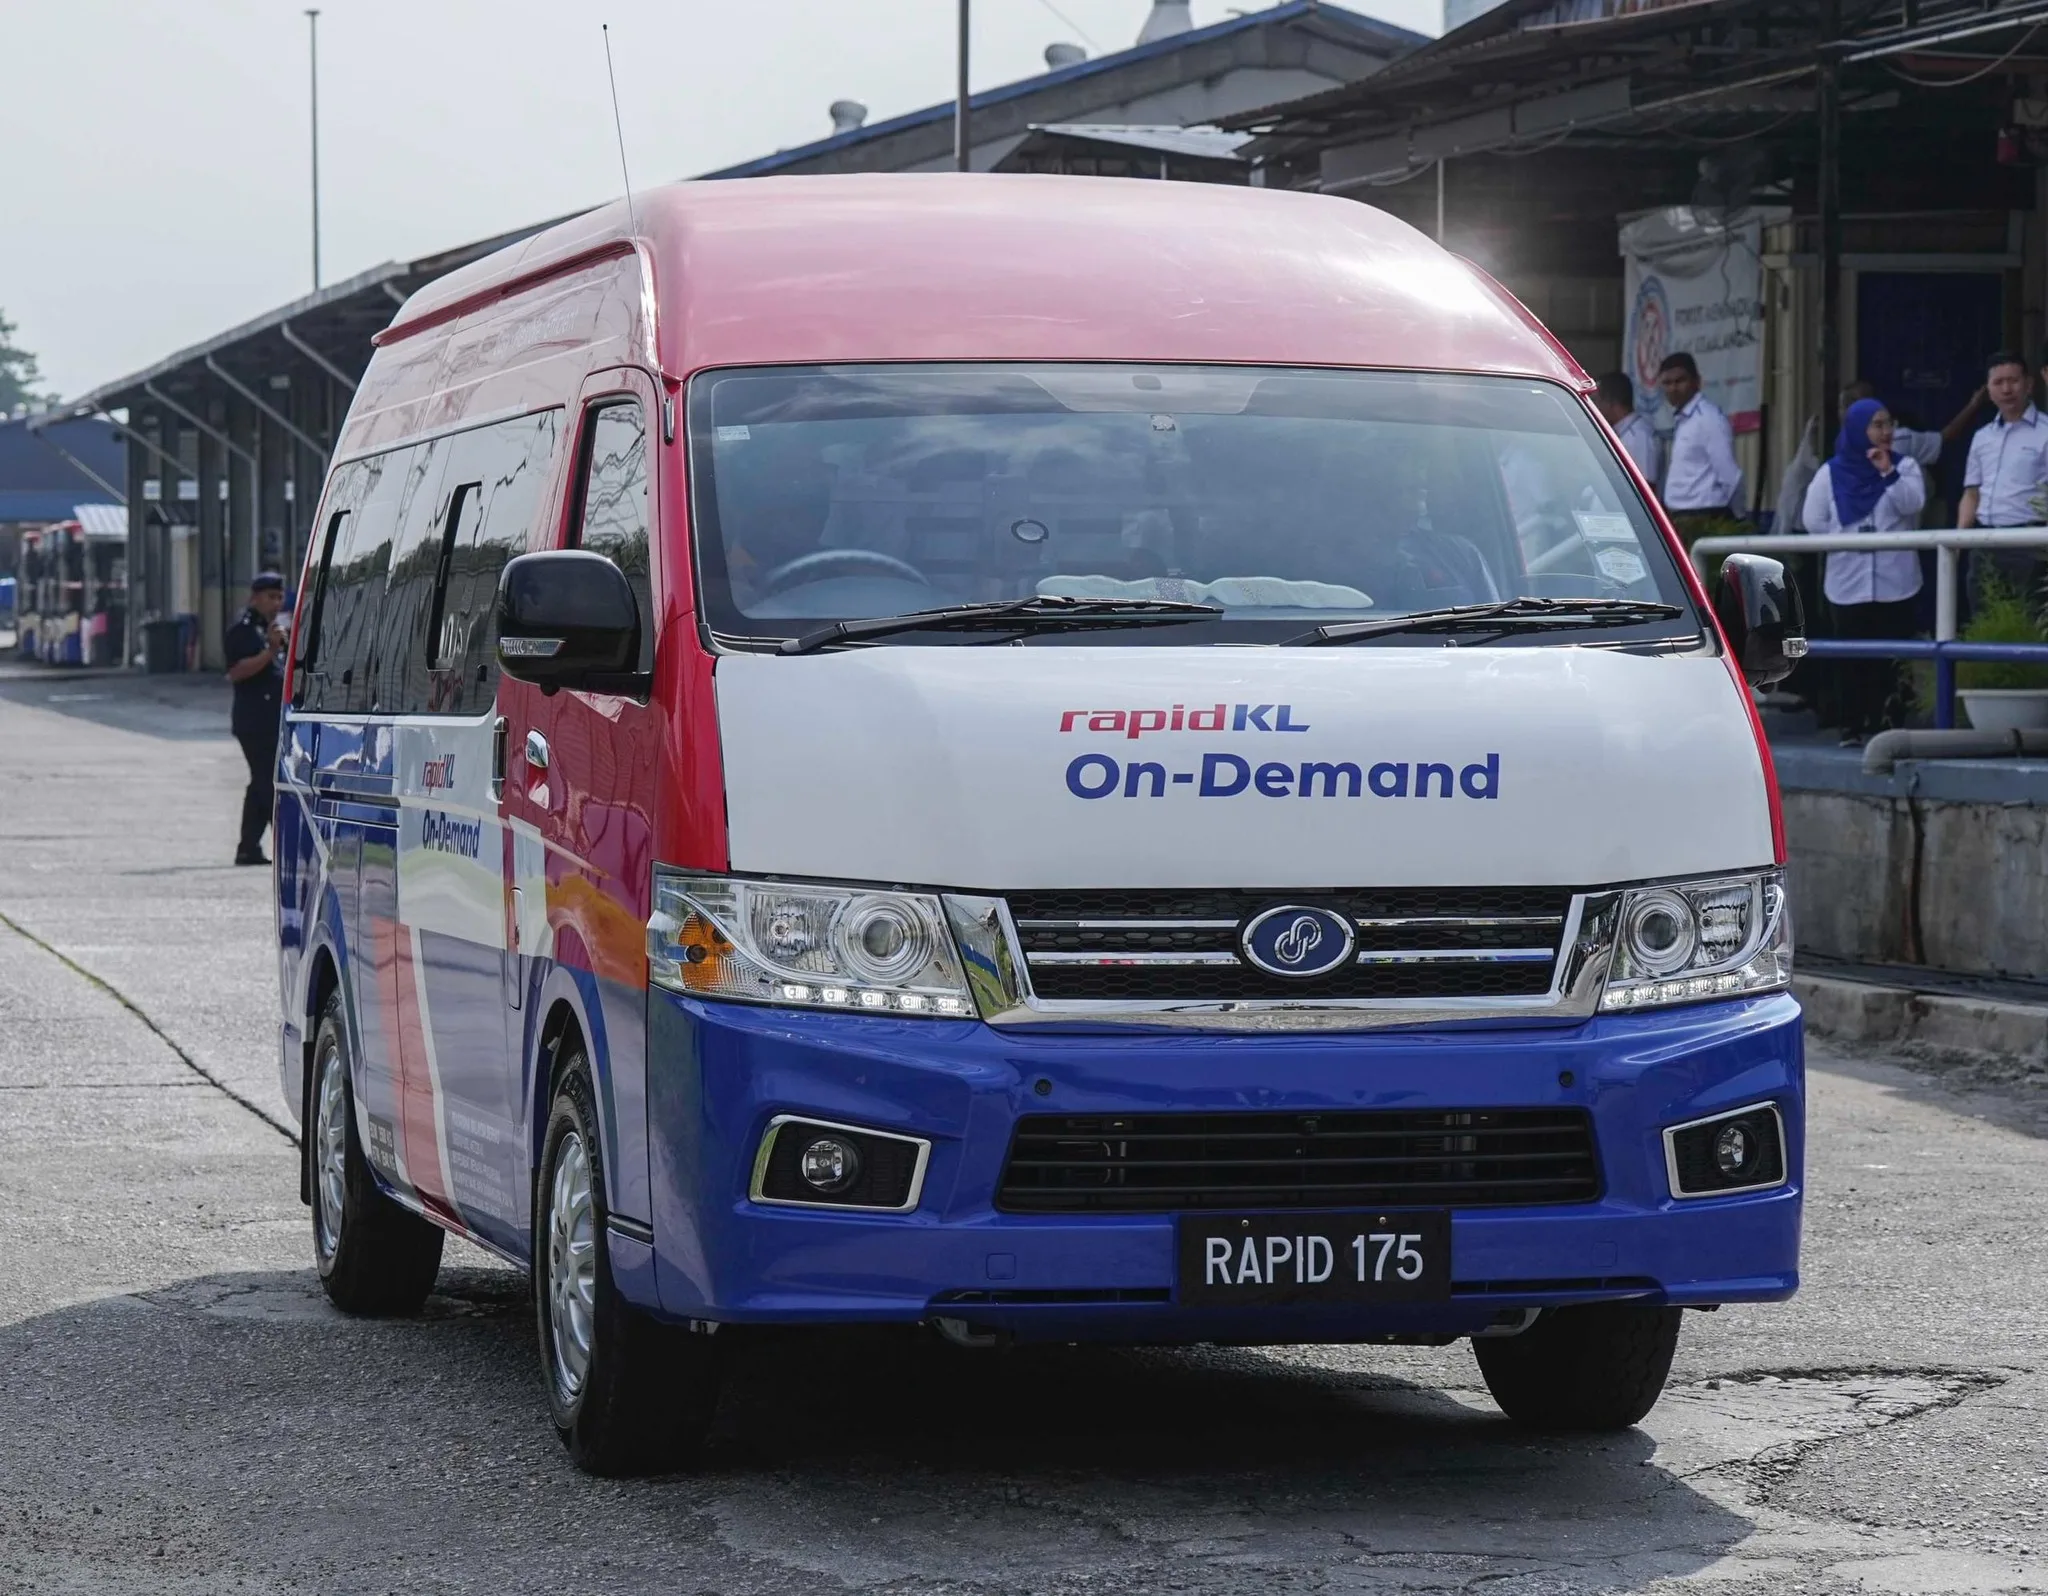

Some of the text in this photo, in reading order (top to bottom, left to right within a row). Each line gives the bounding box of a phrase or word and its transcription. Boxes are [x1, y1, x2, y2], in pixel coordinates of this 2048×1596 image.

[1059, 704, 1311, 739] rapidKL
[421, 754, 455, 796] rapidKL
[1065, 753, 1500, 799] On-Demand
[422, 809, 481, 859] On-Demand
[1206, 1234, 1424, 1285] RAPID 175
